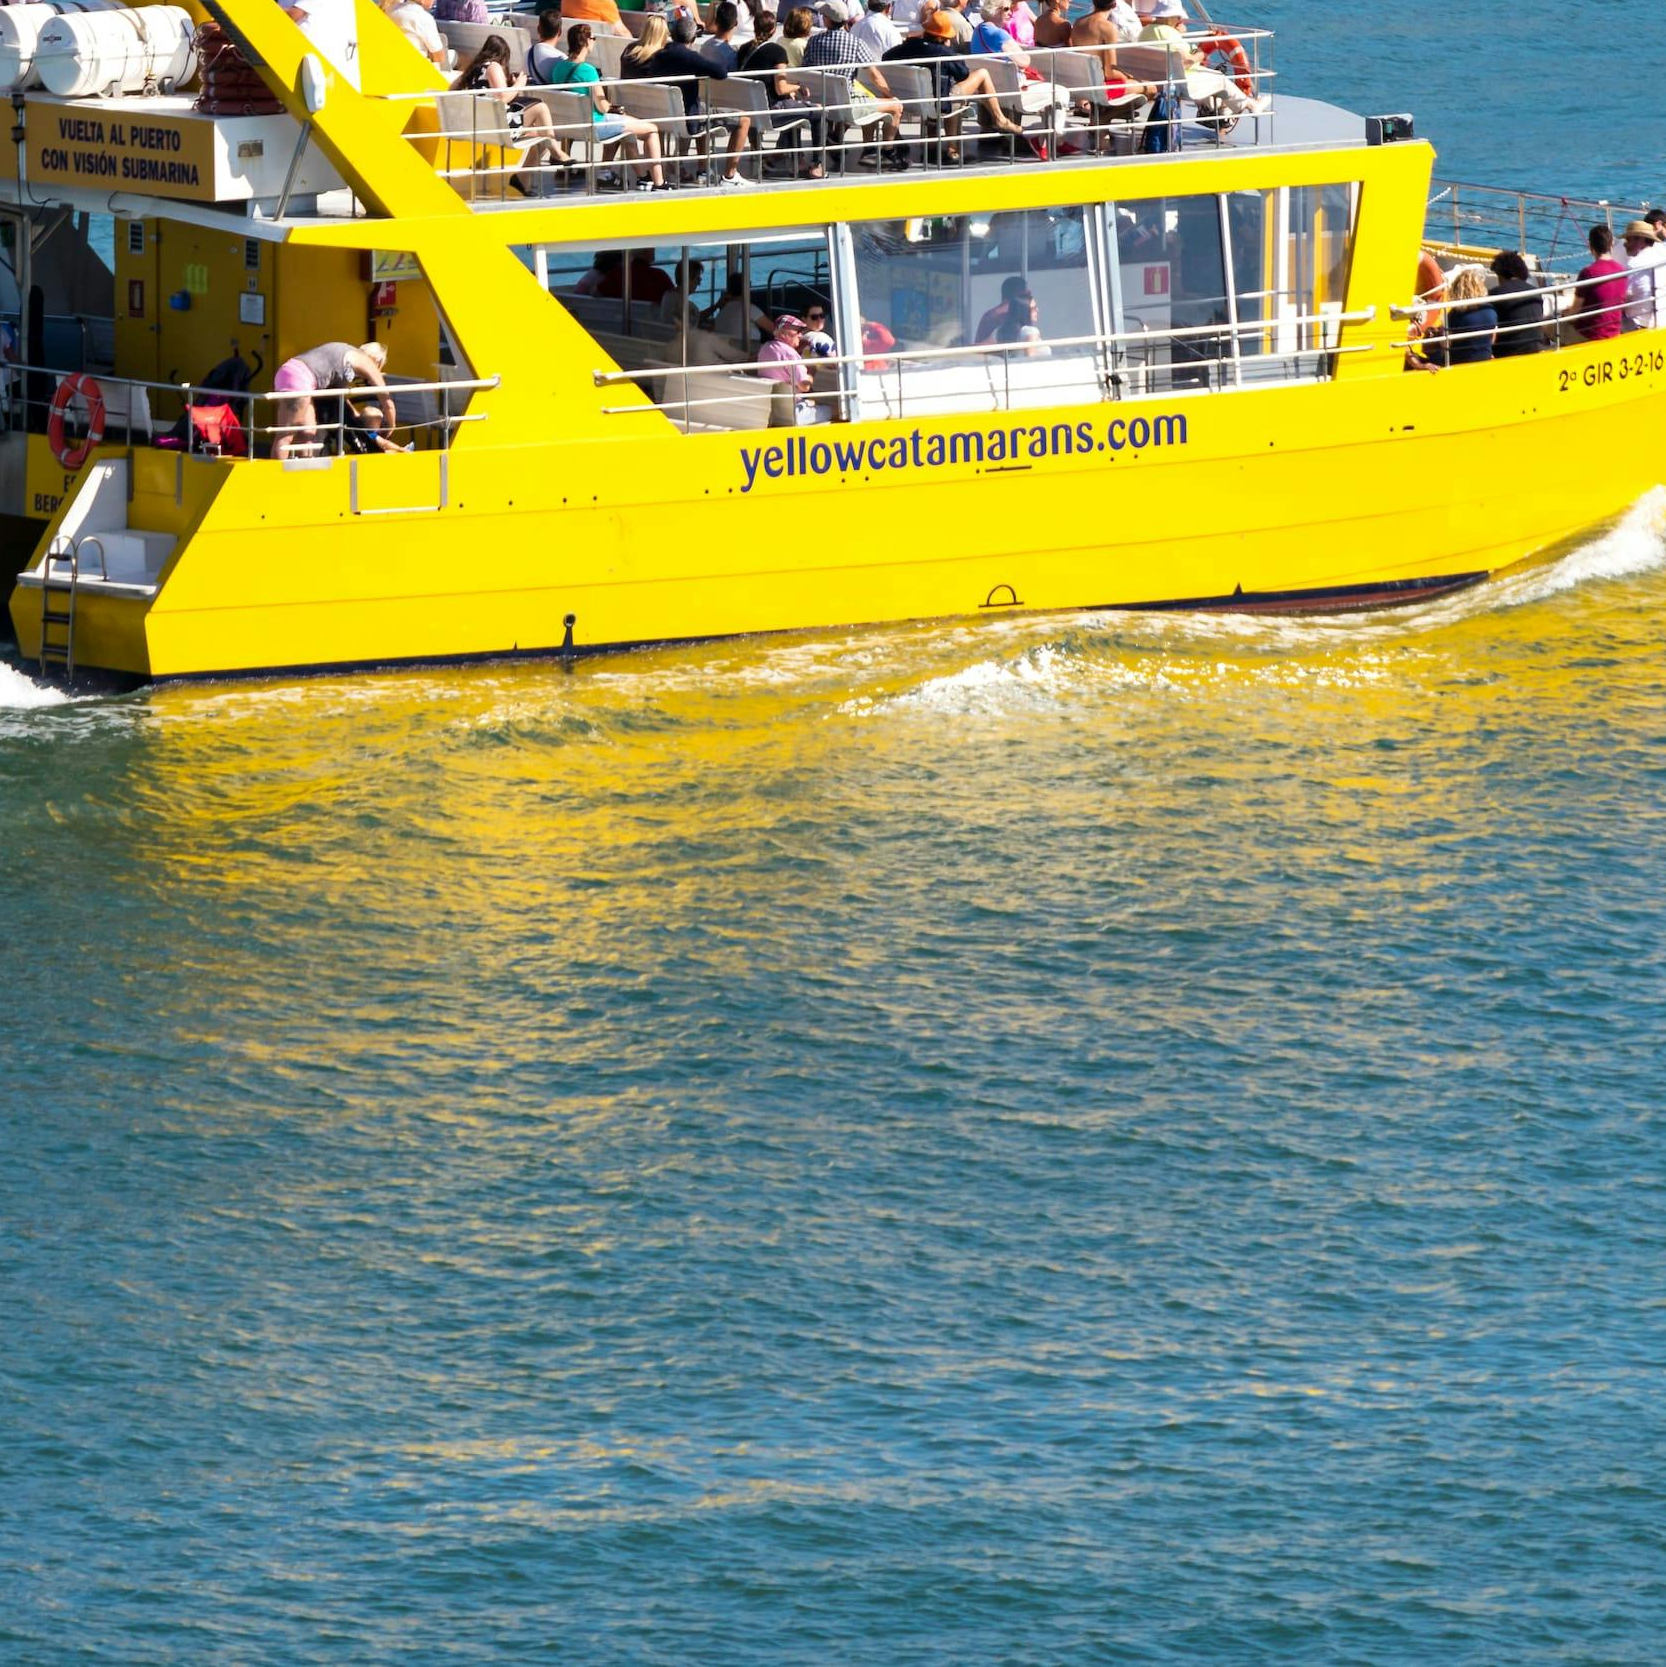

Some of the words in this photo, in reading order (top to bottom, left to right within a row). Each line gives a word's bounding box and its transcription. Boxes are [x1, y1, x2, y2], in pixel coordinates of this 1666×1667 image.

[59, 117, 105, 144] VUELTA
[109, 123, 126, 146] AL
[130, 125, 181, 152] PUERTO
[41, 147, 68, 171] CON
[74, 150, 118, 177] VISIÓN
[122, 156, 200, 186] SUBMARINA
[1583, 360, 1613, 386] GIR
[1619, 349, 1664, 380] 3-2-16
[739, 413, 1188, 494] yellowcatamarans.com
